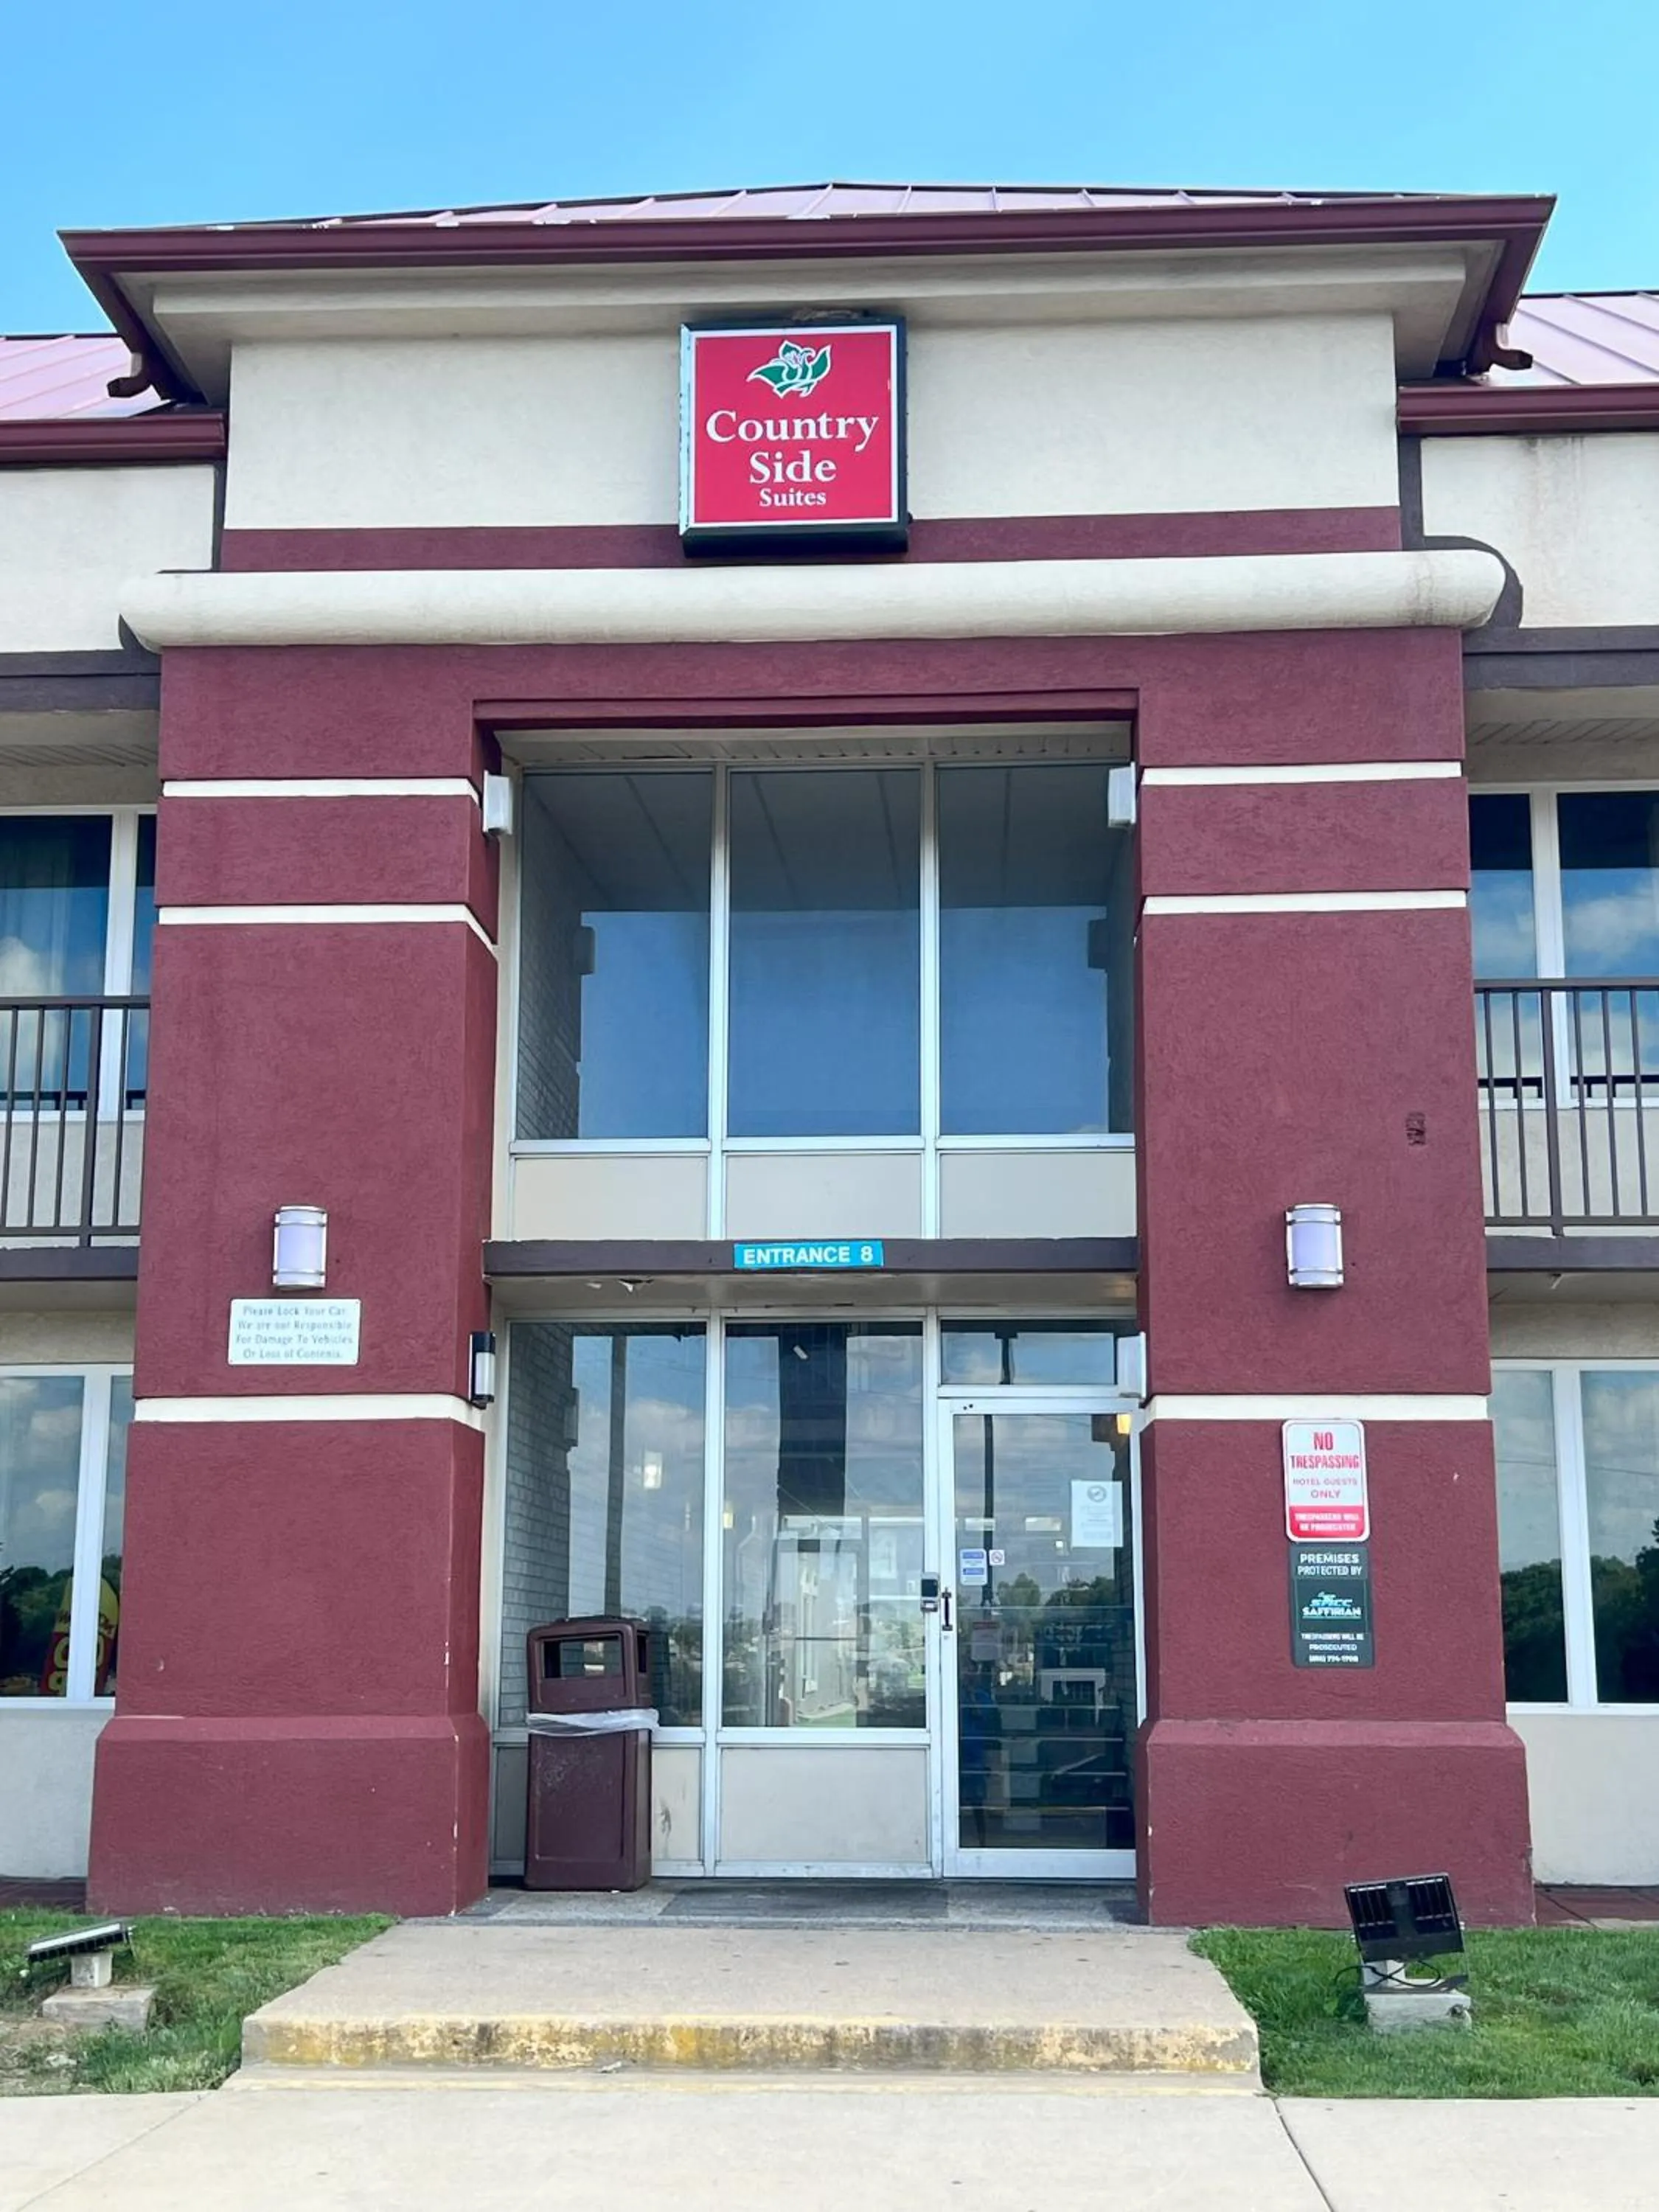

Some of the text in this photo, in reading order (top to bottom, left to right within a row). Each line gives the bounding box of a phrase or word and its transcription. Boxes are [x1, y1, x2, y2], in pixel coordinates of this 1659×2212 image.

[706, 410, 880, 452] Country
[749, 450, 837, 484] Side
[759, 487, 827, 507] Suites
[743, 1245, 874, 1265] ENTRANCE 8
[243, 1305, 347, 1316] Please Lock Your Car
[237, 1321, 352, 1332] We are not Responsible
[236, 1335, 353, 1345] For Damage To Vehicles
[243, 1349, 256, 1358] Or
[260, 1349, 281, 1358] Loss
[284, 1349, 294, 1358] of
[1313, 1431, 1334, 1450] NO
[1290, 1455, 1360, 1470] TRESPASSING
[1293, 1477, 1357, 1486] HOTEL GUESTS
[1310, 1489, 1341, 1499] ONLY
[1300, 1554, 1359, 1564] PREMISES
[1297, 1565, 1363, 1576] PROTECTED BY
